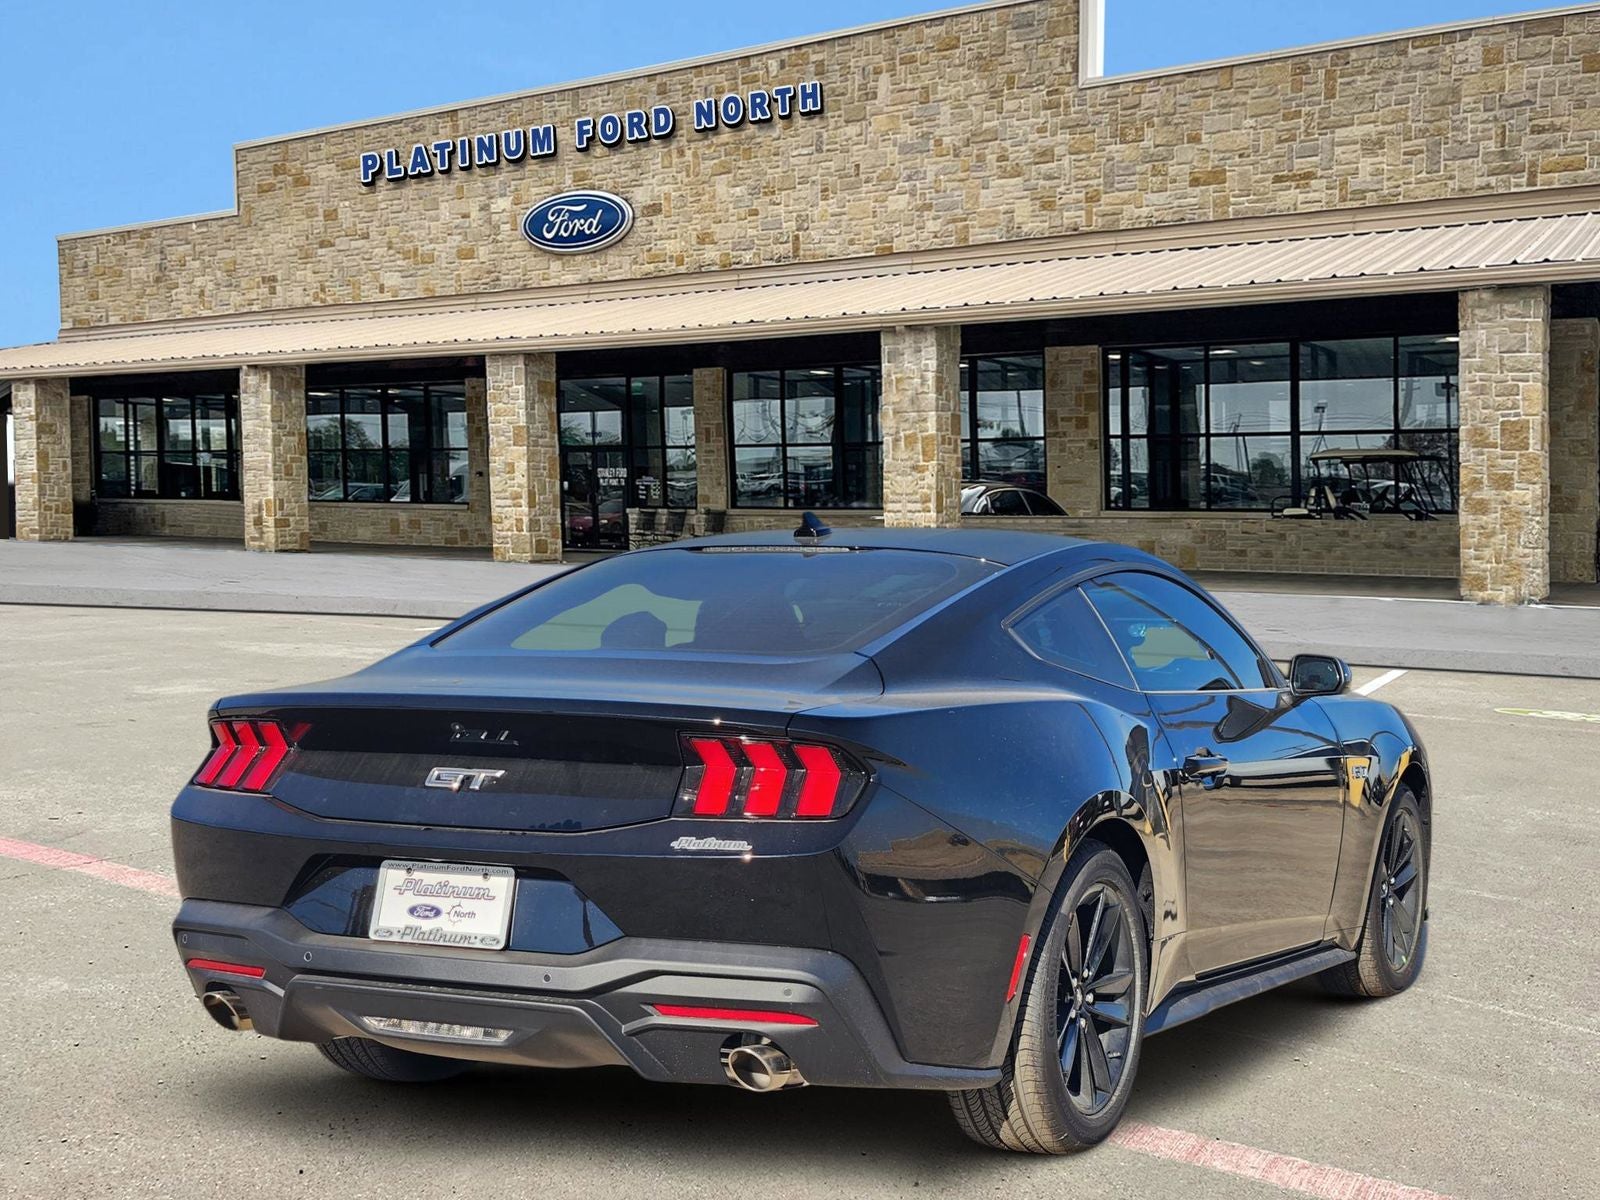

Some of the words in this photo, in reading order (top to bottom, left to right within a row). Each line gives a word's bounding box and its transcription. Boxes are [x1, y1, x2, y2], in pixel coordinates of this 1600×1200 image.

[360, 125, 556, 184] PLATINUM
[576, 106, 674, 150] FORD
[694, 81, 823, 131] NORTH
[542, 204, 602, 239] Ford
[425, 767, 505, 790] GT
[387, 862, 509, 875] www.PlatinumFordNorth.com
[393, 878, 496, 900] Platinum
[453, 910, 477, 919] North
[401, 925, 477, 945] Platinum
